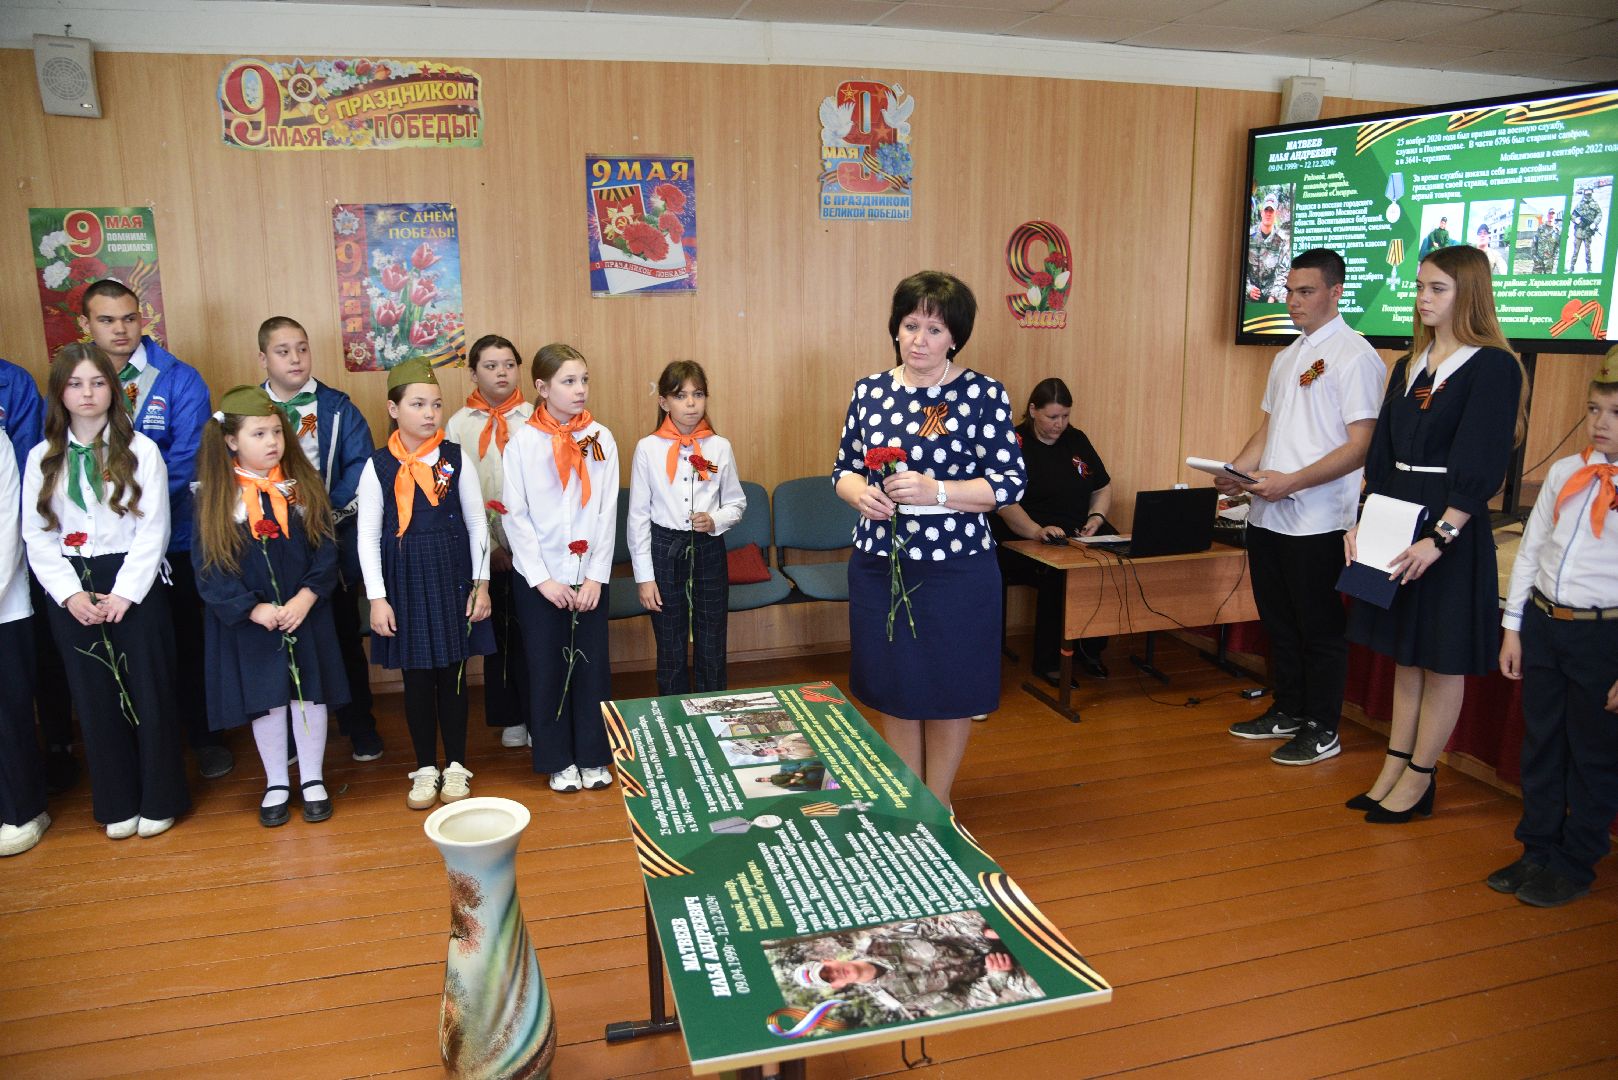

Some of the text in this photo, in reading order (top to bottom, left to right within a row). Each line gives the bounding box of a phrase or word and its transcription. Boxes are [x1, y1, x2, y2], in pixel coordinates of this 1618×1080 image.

[224, 62, 281, 142] 9
[313, 82, 474, 125] С ПРАЗДНИКОМ
[268, 126, 324, 147] МАЯ
[373, 114, 479, 143] ПОБЕДЫ!
[837, 81, 897, 193] 9
[1397, 138, 1404, 146] 25
[1427, 134, 1441, 142] 2020
[1585, 144, 1603, 153] 2022
[823, 146, 859, 159] МАЯ
[591, 160, 688, 186] 9 МАЯ
[824, 195, 910, 207] С ПРАЗДНИКОМ
[104, 215, 144, 230] МАЯ
[399, 211, 455, 223] С ДНЕМ
[823, 206, 910, 219] ВЕЛИКОЙ ПОБЕДЫ!
[64, 210, 104, 258] 9
[106, 232, 147, 242] ПОМНИМ!
[388, 227, 455, 240] ПОБЕДЫ!
[107, 243, 154, 253] ГОРДИМСЯ!
[336, 241, 363, 277] 9
[1006, 221, 1072, 320] 9
[671, 918, 701, 971] МАТВЕЕВ
[684, 896, 731, 996] ИЛЬЯ АНДРЕЕВИЧ
